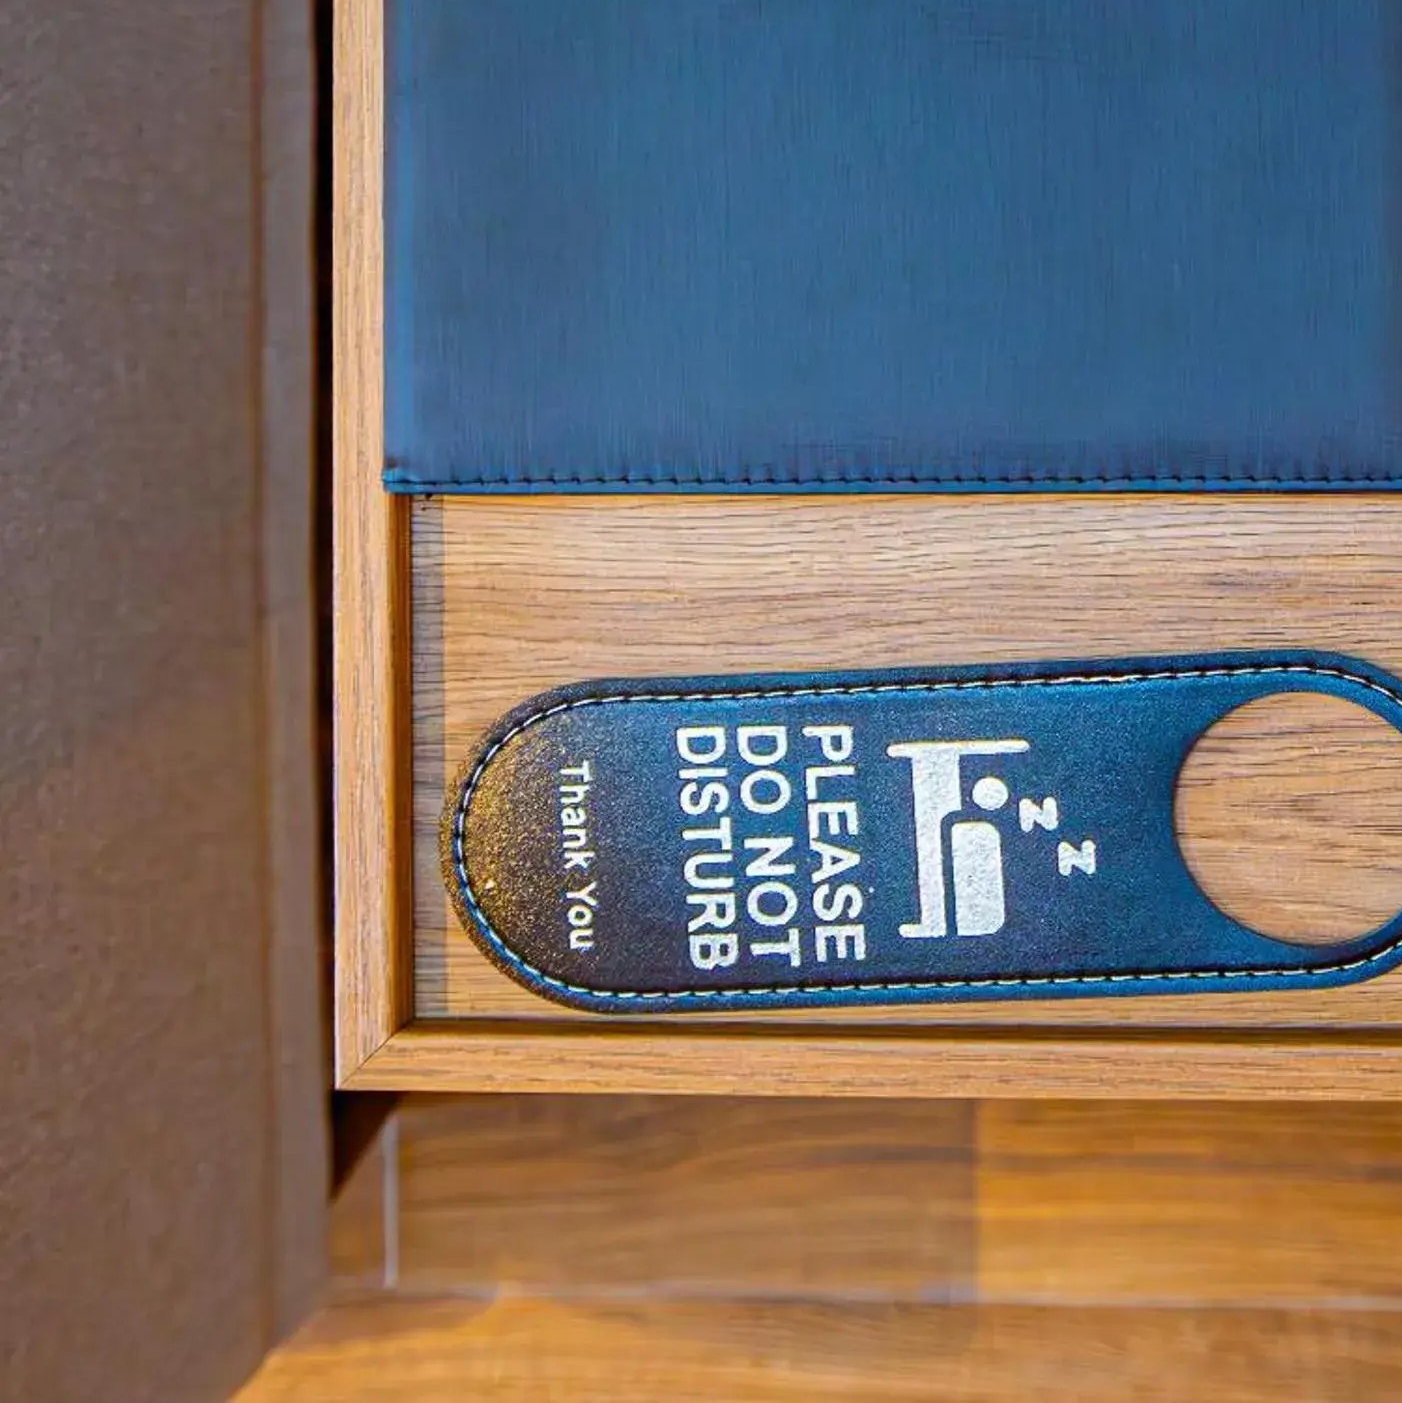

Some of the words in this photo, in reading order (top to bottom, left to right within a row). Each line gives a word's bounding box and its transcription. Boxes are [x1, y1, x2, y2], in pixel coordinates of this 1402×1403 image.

[555, 760, 590, 868] Thank
[737, 725, 790, 815] DO
[676, 726, 739, 971] DISTURB
[743, 835, 800, 967] NOT
[803, 724, 866, 962] PLEASE
[561, 882, 598, 951] You
